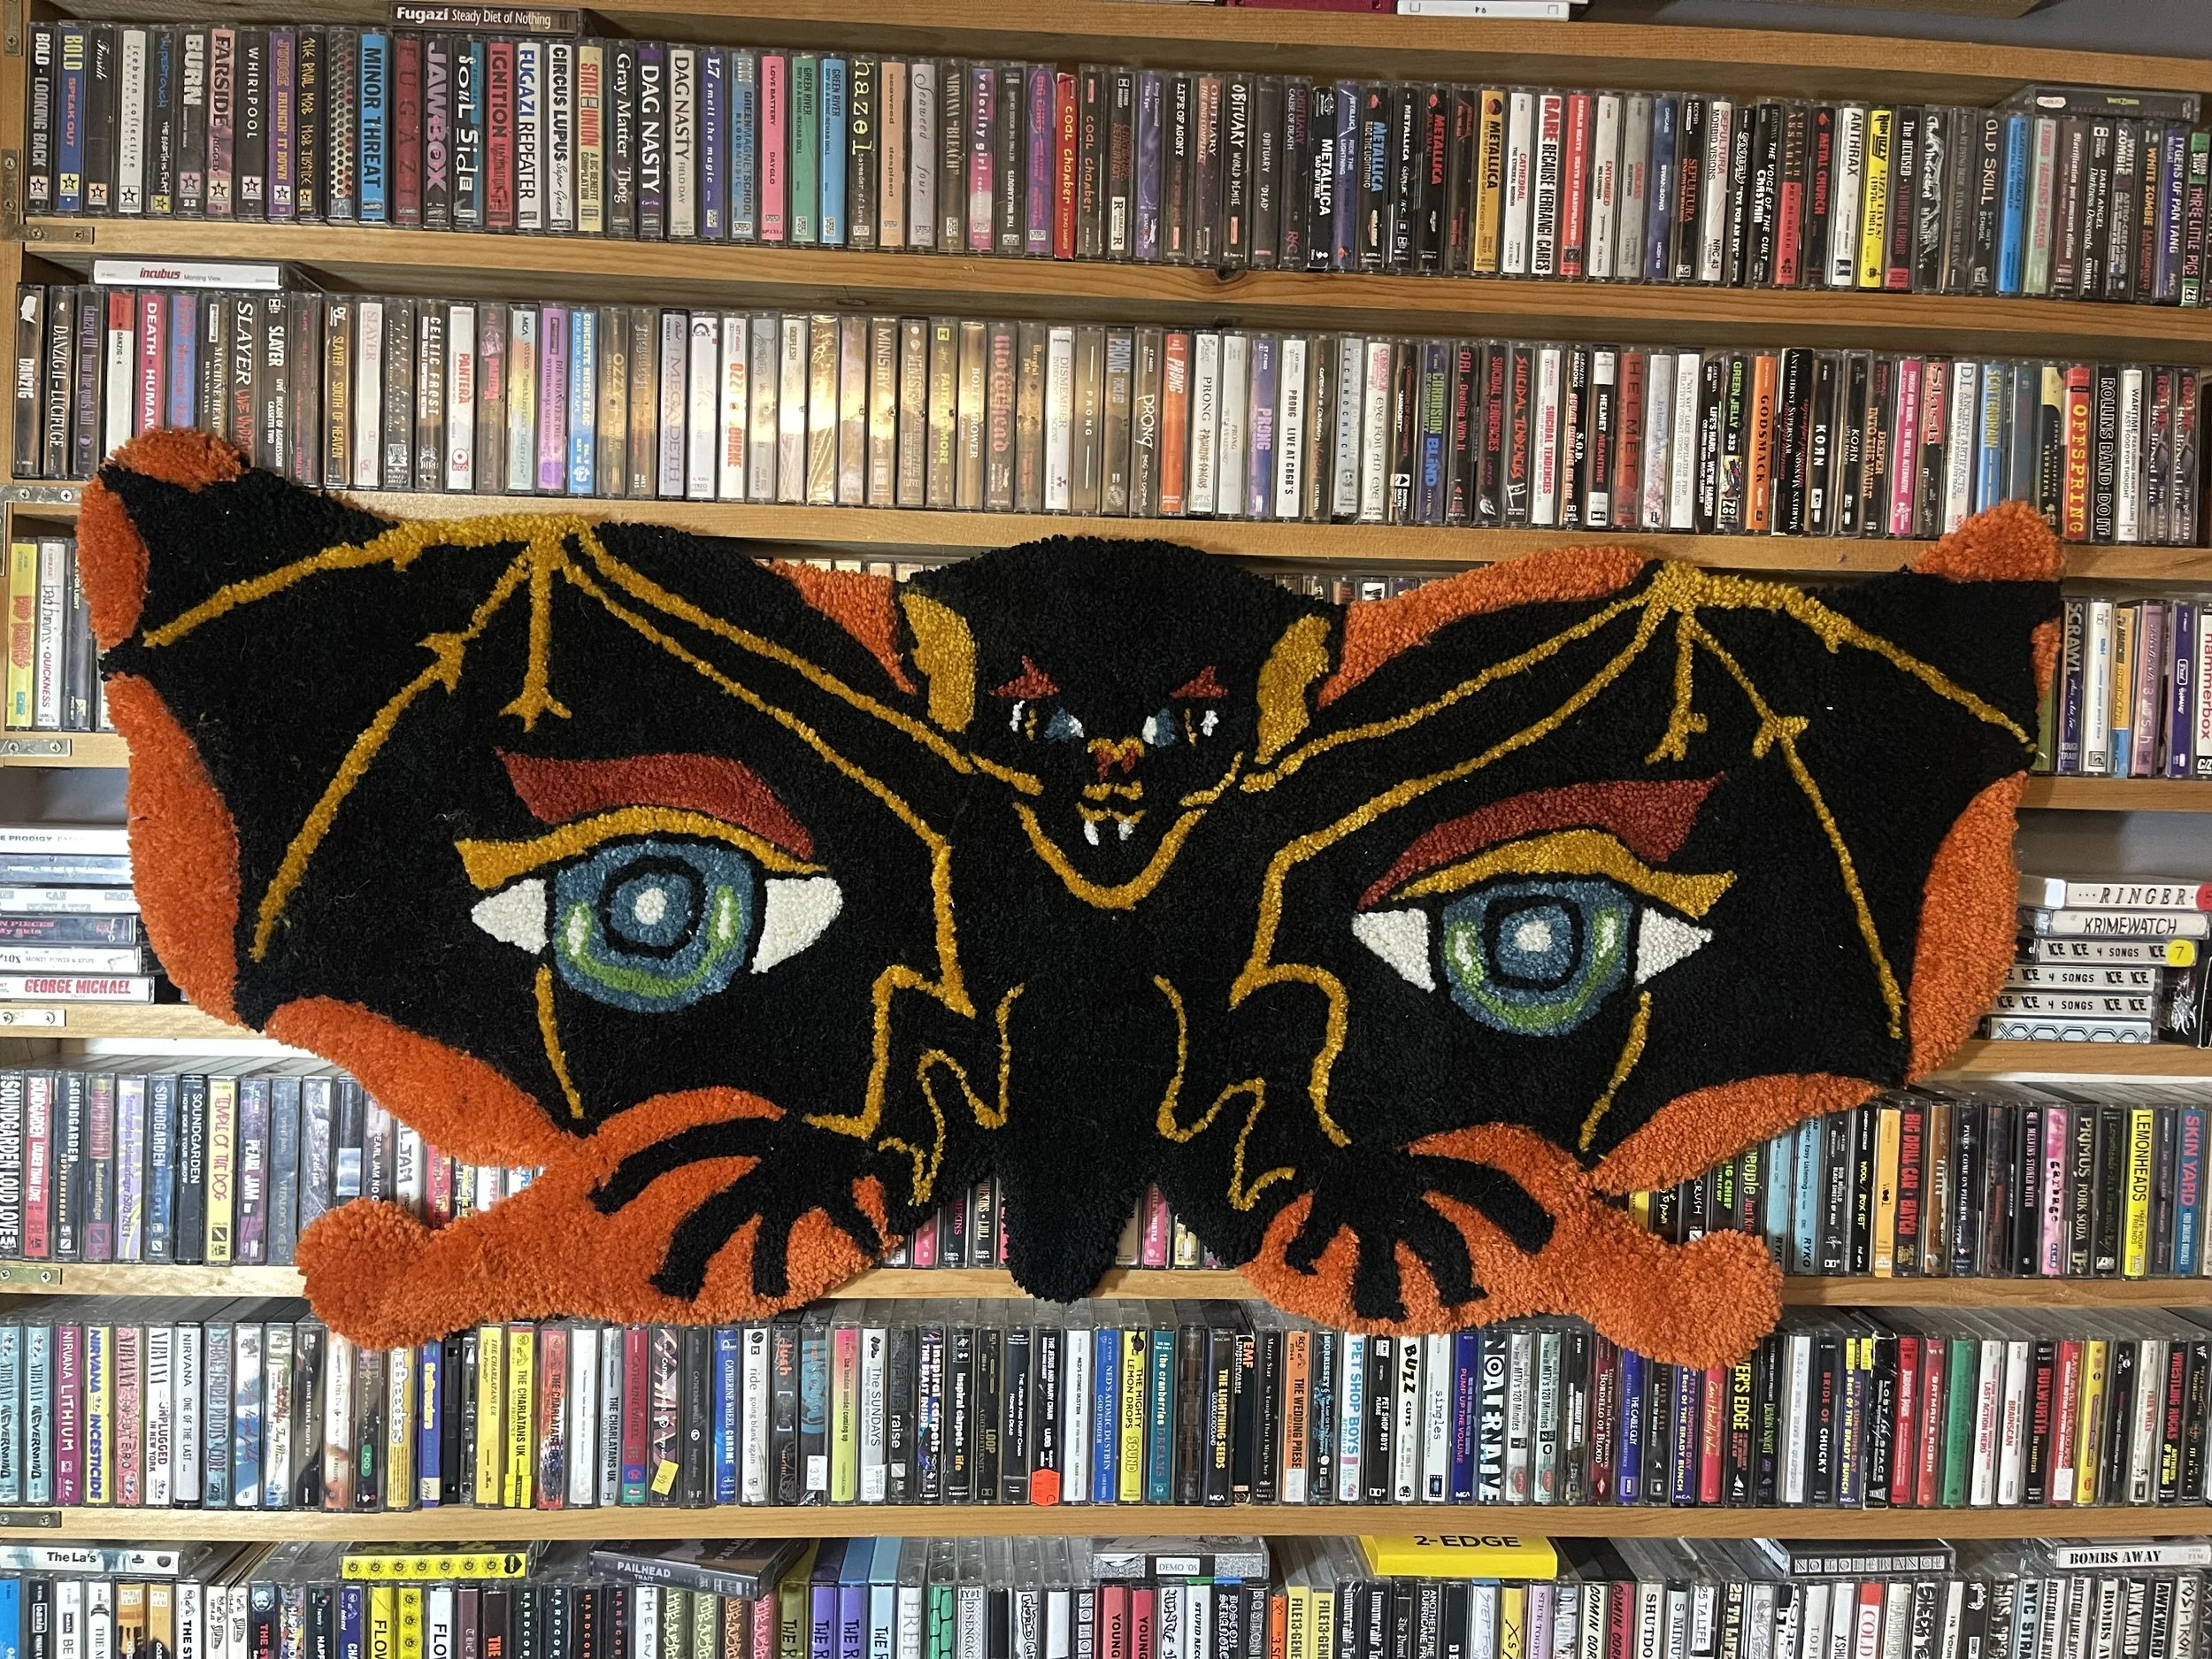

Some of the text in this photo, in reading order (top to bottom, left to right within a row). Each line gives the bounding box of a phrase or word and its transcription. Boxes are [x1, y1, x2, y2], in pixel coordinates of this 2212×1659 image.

[396, 7, 550, 28] Fugazi Steady Diet of Nothing
[32, 33, 50, 166] BOLD LOOKING BACK
[64, 35, 83, 147] BOLD SPEAK OUT
[183, 35, 204, 105] BURN
[212, 35, 231, 127] FARSIDE
[247, 48, 258, 138] WHIRLPOOL
[490, 50, 507, 138] IGNITION
[613, 53, 631, 96] Gray
[708, 58, 719, 78] L7
[276, 40, 289, 180] JUDGE BRINGIN' IT DOWN
[363, 48, 381, 188] MINOR THREAT
[427, 42, 447, 192] JAWBOX
[519, 50, 535, 200] FUGAZI REPEATER
[553, 48, 568, 161] CIRCUS LUPUS
[617, 102, 631, 157] Matter
[641, 65, 659, 193] DAG NASTY
[674, 57, 689, 159] DAG NASTY
[851, 61, 874, 155] hazel
[1176, 108, 1184, 118] OF
[1232, 84, 1246, 148] OBITUARY
[1175, 121, 1184, 156] AGONY
[1717, 110, 1727, 174] SEPULTURA
[1848, 112, 1861, 176] ANTHRAX
[1981, 120, 1998, 204] OLD SKULL
[1318, 139, 1333, 216] METALLICA
[1536, 97, 1559, 271] RARE BECAUSE KERRANG! CARES
[2186, 188, 2202, 276] THREE LITTLE PIGS
[140, 268, 180, 279] incubus
[146, 303, 157, 356] DEATH
[235, 301, 253, 384] SLAYER
[18, 358, 35, 399] DANZIG
[331, 336, 345, 458] SLAYER SOUTH OF HEAVEN
[457, 353, 471, 404] PANTERA
[1256, 408, 1272, 450] PRONG
[1285, 389, 1297, 495] PRONG LIVE AT CBGB'S
[1730, 398, 1741, 428] JELLY
[1755, 395, 1770, 481] GODSMACK
[1542, 405, 1555, 494] SUICIDAL TENDENCIES
[2069, 404, 2085, 533] OFFSPRING
[2095, 377, 2115, 533] ROLLINS BAND: DO IT
[2067, 603, 2082, 675] SCRAWL
[42, 652, 50, 707] QUICKNESS
[2048, 943, 2065, 956] ICE
[2072, 943, 2089, 956] ICE
[2097, 948, 2102, 956] 4
[2149, 946, 2166, 957] ICE
[2084, 918, 2177, 933] KRIMEWATCH
[2175, 947, 2185, 959] 7
[25, 979, 131, 994] GEORGE MICHAEL
[1997, 995, 2015, 1009] ICE
[2021, 995, 2039, 1009] ICE
[2062, 1001, 2093, 1010] SONGS
[2104, 998, 2122, 1010] ICE
[2128, 998, 2147, 1011] ICE
[2022, 969, 2149, 984] ICE 4 SONGS ICE ICE
[67, 1081, 81, 1163] SOUNDGARDEN
[190, 1093, 203, 1184] SOUNDGARDEN
[0, 1080, 20, 1240] SOUNDGARDEN LOUD LOVE
[244, 1139, 258, 1200] PEARL JAM
[2076, 1117, 2092, 1240] PRIMUS PORK SODA
[2133, 1115, 2150, 1202] LEMONHEADS
[2181, 1116, 2200, 1205] SKIN YARD
[1803, 1237, 1812, 1267] RYKO
[183, 1334, 192, 1386] NIRVANA
[1241, 1342, 1254, 1369] EMF
[1403, 1345, 1417, 1393] BUZZ
[60, 1331, 73, 1450] NIRVANA LITHIUM
[90, 1330, 101, 1499] NIRVANA INCESTICIDE
[185, 1415, 191, 1424] OF
[516, 1371, 527, 1457] THE CHARLATANS UK
[871, 1391, 880, 1446] SUNDAYS
[956, 1373, 965, 1406] inspiral
[1216, 1370, 1228, 1469] THE LIGHTNING SEEDS
[1294, 1399, 1303, 1435] WEDDING
[1348, 1341, 1362, 1456] PET SHOP BOYS
[1818, 1372, 1831, 1474] BRIDE OF CHUCKY
[891, 1416, 901, 1448] raise
[955, 1409, 964, 1447] carpets
[1125, 1436, 1139, 1472] SOUND
[1293, 1439, 1302, 1468] PRESE
[47, 1551, 96, 1563] The La's
[618, 1562, 671, 1578] PAILHEAD
[2069, 1550, 2161, 1563] BOMBS AWAY
